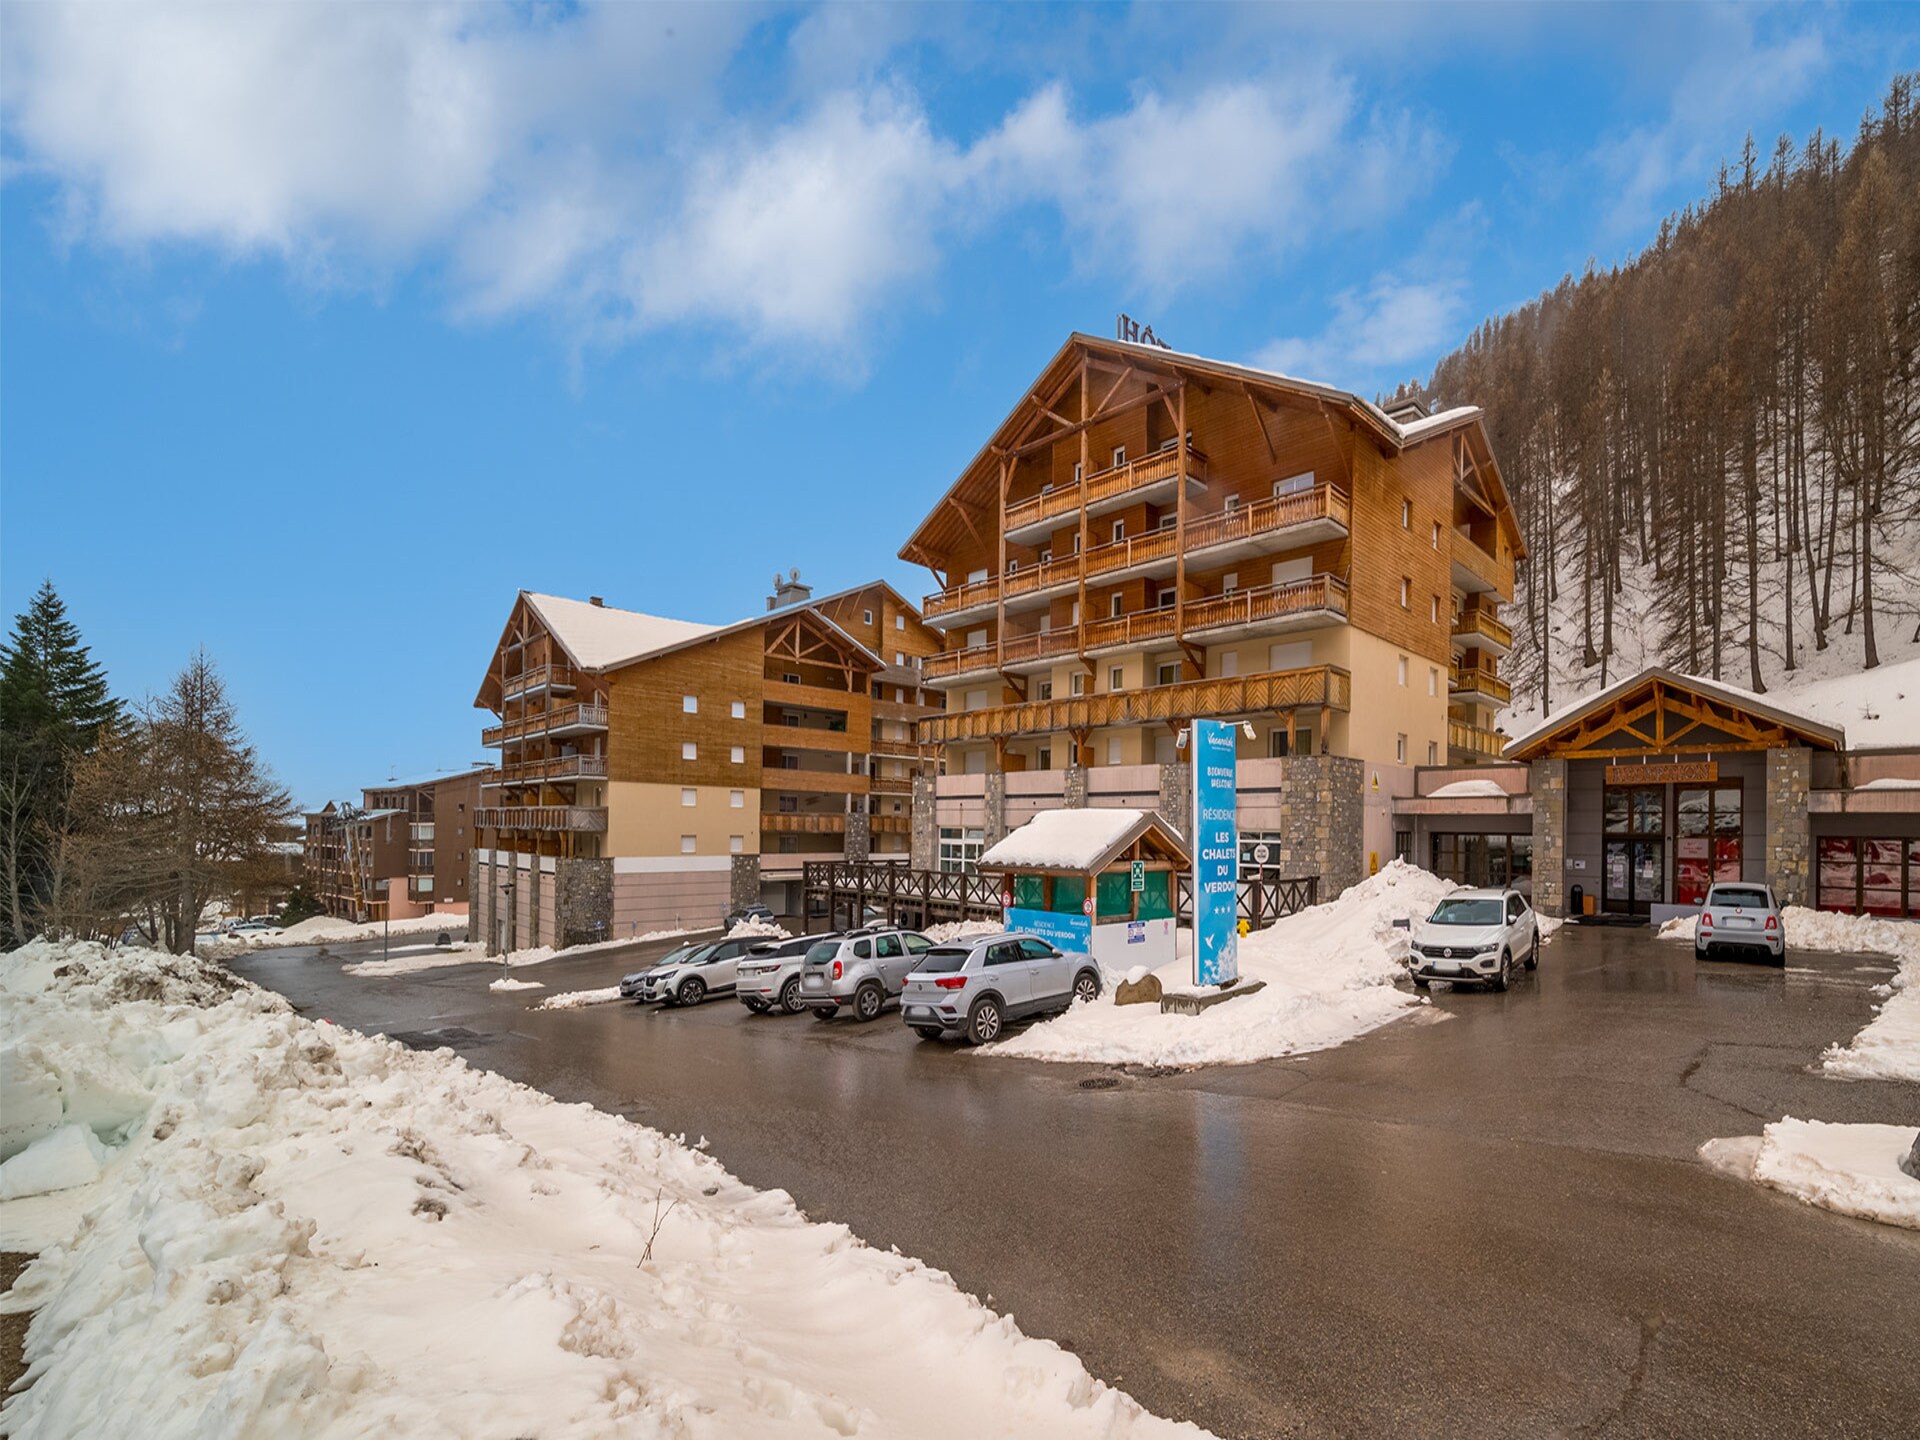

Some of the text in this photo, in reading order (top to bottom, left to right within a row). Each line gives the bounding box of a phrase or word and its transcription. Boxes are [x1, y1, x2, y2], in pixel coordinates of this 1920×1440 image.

[1121, 313, 1171, 350] HÔ
[1211, 778, 1233, 789] WELCOME
[1215, 831, 1230, 843] LES
[1202, 847, 1236, 860] CHALETS
[1217, 864, 1229, 876] DU
[1024, 926, 1046, 936] CHALETS
[1046, 929, 1054, 937] DU
[1054, 930, 1076, 940] VERDON
